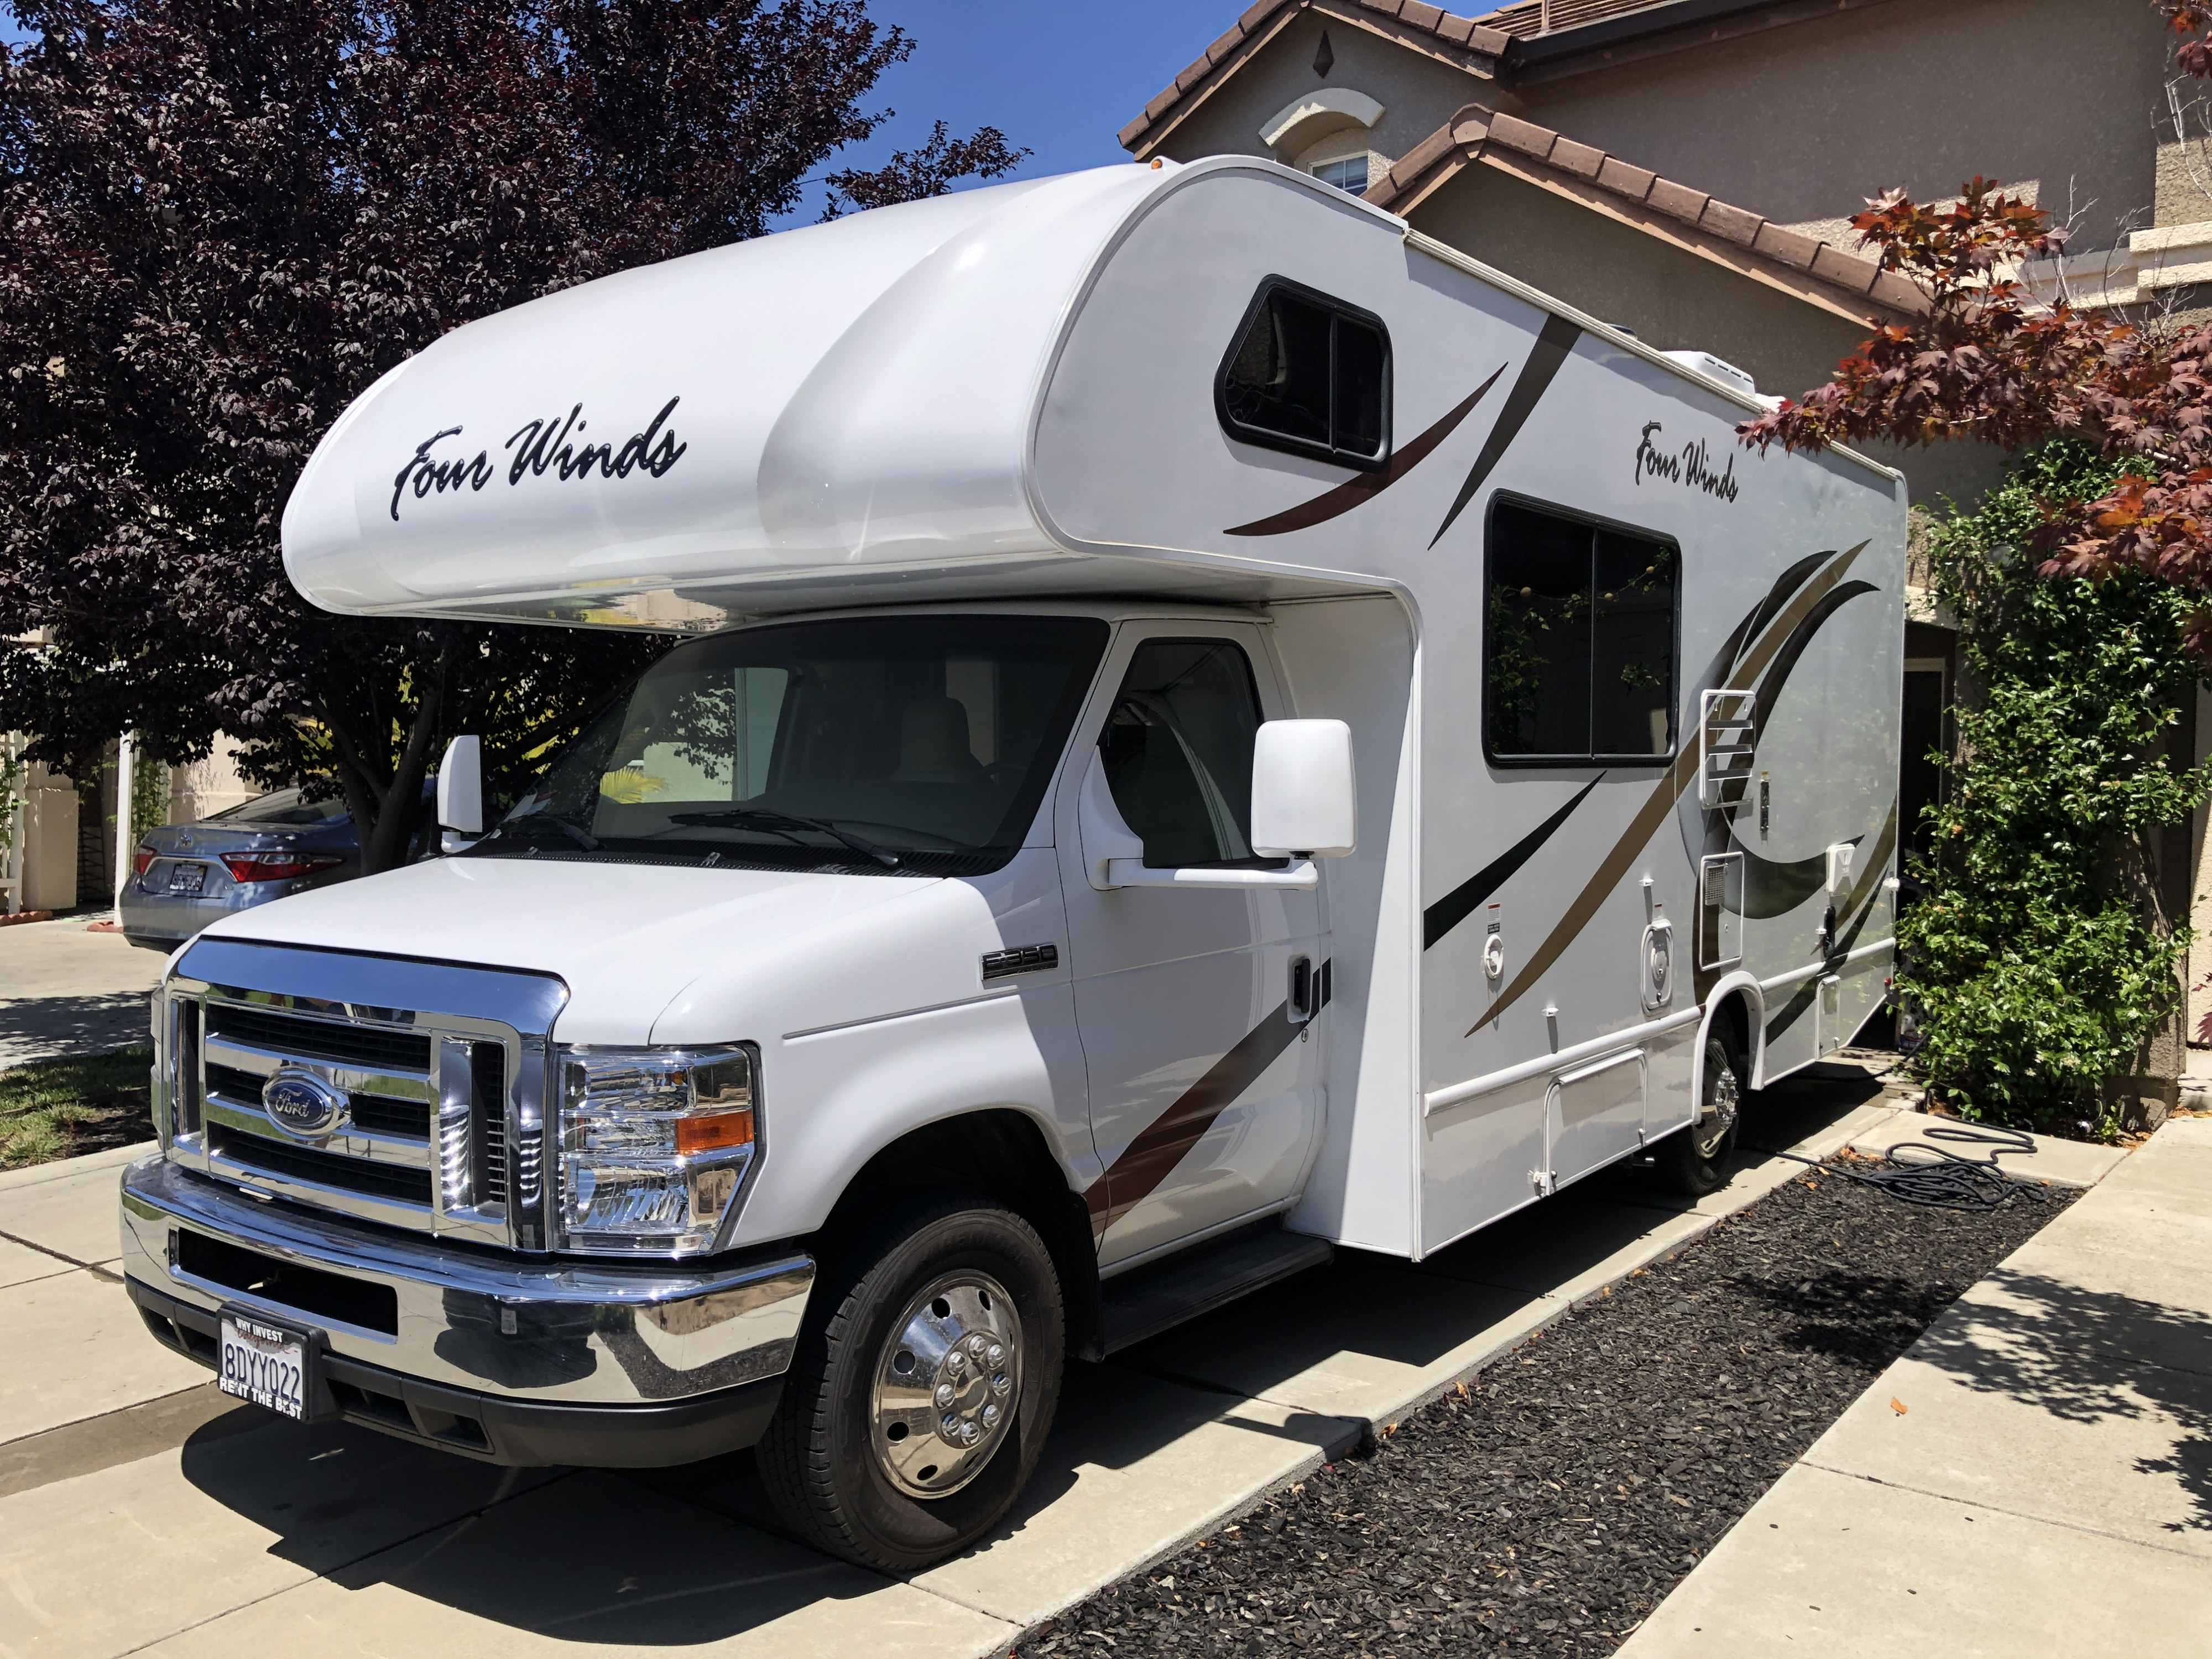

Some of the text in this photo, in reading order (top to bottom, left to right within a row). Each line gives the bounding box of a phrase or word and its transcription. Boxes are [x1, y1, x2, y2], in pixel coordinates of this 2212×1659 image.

[390, 395, 687, 521] Four Winds
[1635, 420, 1739, 504] Four Winds
[275, 1088, 310, 1118] Ford
[235, 1317, 283, 1343] WHY INVEST
[225, 1343, 300, 1405] 8DYY022
[251, 1387, 273, 1408] THE
